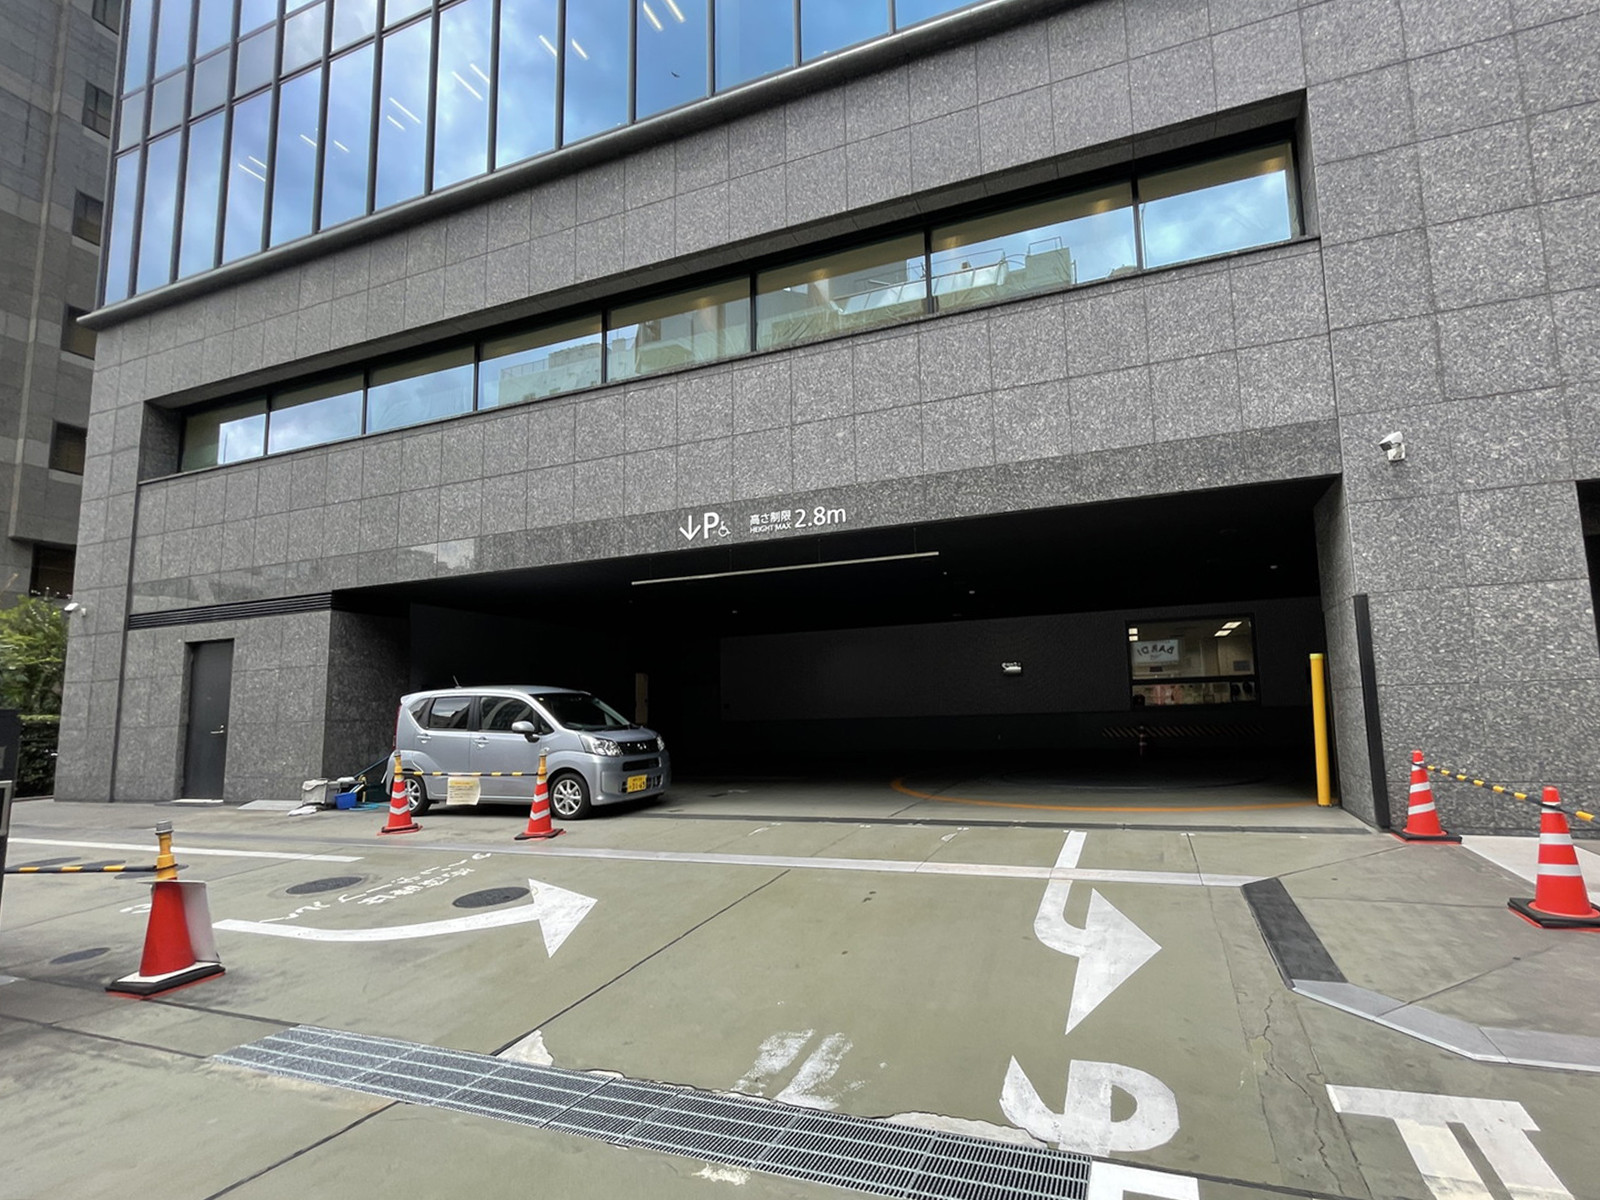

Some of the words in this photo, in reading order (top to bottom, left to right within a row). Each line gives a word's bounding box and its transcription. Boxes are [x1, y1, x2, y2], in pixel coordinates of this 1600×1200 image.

[703, 512, 720, 539] P
[749, 509, 791, 526] 高さ制限
[794, 506, 847, 528] 2.8m
[749, 524, 774, 533] HEIGHT
[775, 523, 792, 532] MAX
